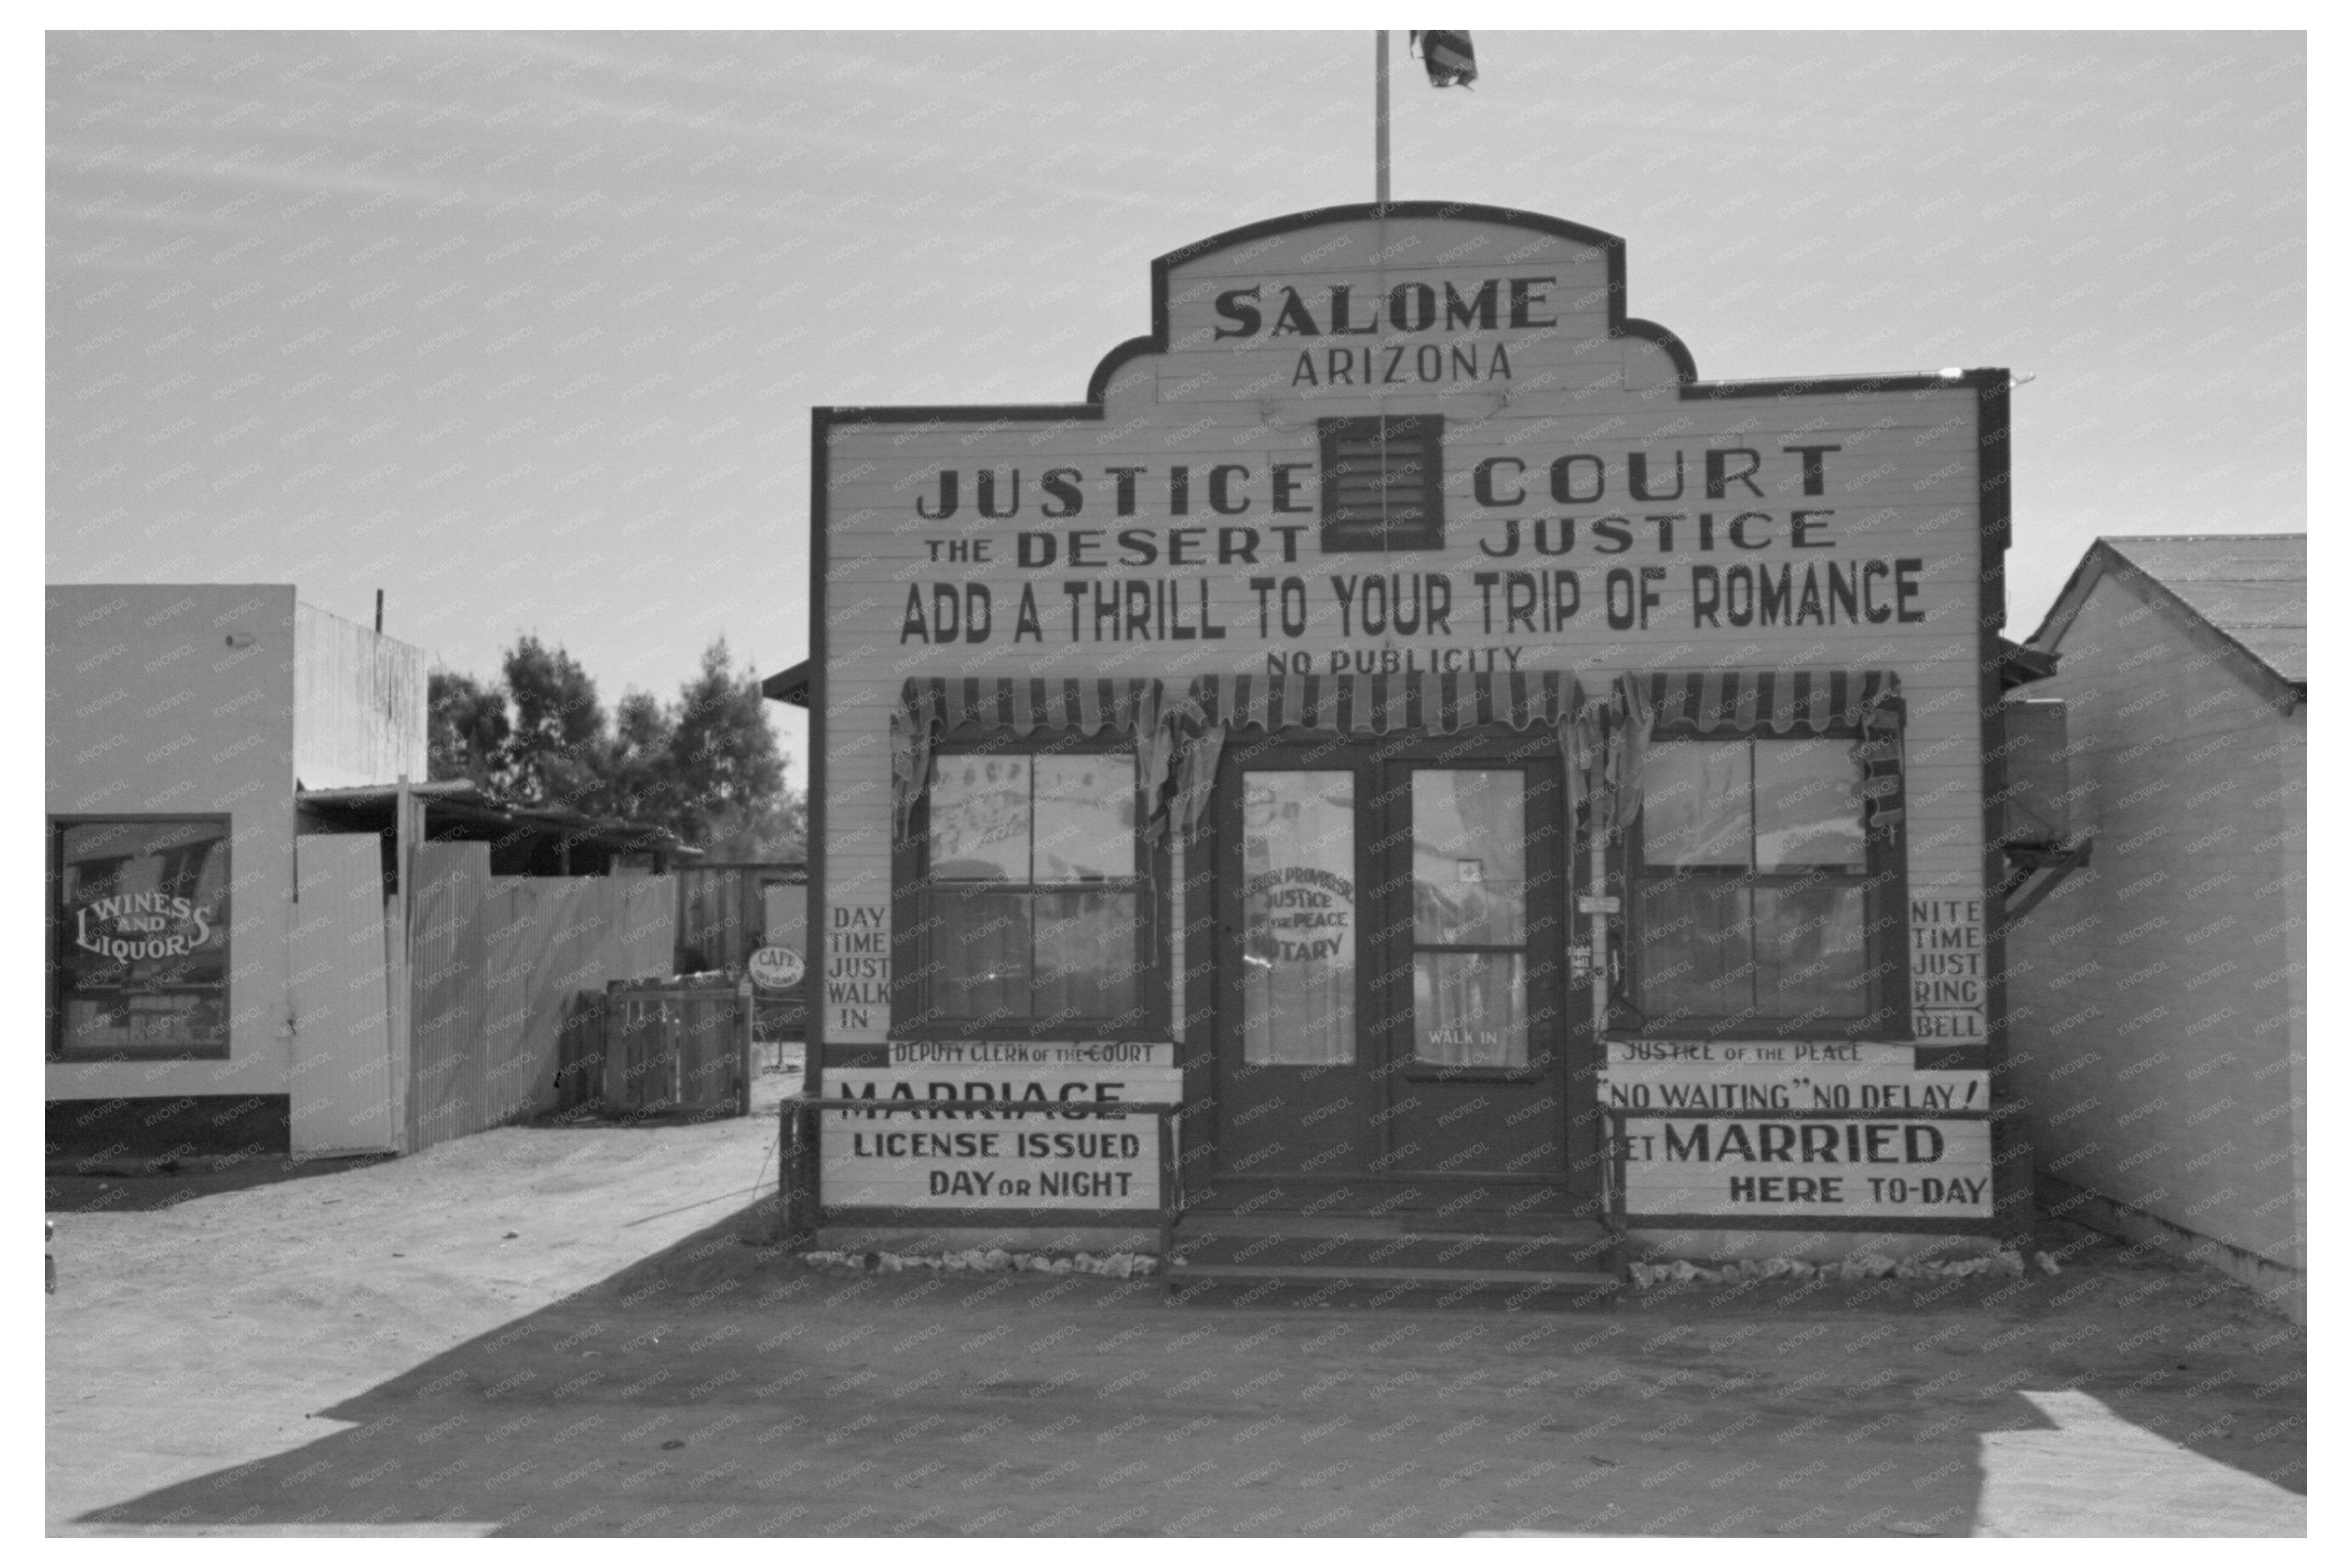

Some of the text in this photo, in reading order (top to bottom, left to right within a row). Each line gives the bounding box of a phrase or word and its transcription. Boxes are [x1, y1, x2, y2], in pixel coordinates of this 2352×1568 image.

[1214, 277, 1558, 341] SALOME
[1292, 342, 1512, 387] ARIZONA
[917, 445, 1842, 520] JUSTICE COURT
[925, 509, 1837, 568] THE DESERT JUSTICE
[901, 558, 1926, 644] ADD A THRILL TO YOUR TRIP OF ROMANCE
[1267, 646, 1523, 675] NO PUBLICITY
[90, 893, 191, 921] WINES
[1264, 887, 1332, 909] JUSTICE
[834, 907, 886, 928] DAY
[1294, 911, 1349, 928] PEACE
[1912, 901, 1980, 923] NITE
[76, 905, 211, 965] LIQUORS
[117, 916, 166, 932] AND
[829, 932, 887, 953] TIME
[1913, 927, 1980, 949] TIME
[828, 957, 890, 978] JUST
[1914, 953, 1981, 975] JUST
[828, 982, 891, 1003] WALK
[1914, 980, 1977, 1002] RING
[841, 1008, 868, 1028] IN
[1916, 1015, 1982, 1037] BELL
[1429, 1030, 1498, 1045] WALK IN
[895, 1042, 1155, 1063] DEPUTY CLERK OF THE COURT
[1623, 1042, 1863, 1062] JUSTICE OF THE PEACE
[841, 1082, 1127, 1120] MARRIAGE
[1814, 1084, 1851, 1109] NO
[854, 1132, 1140, 1159] LICENSE ISSUED
[1665, 1123, 1945, 1163] MARRIED
[929, 1170, 1133, 1197] DAY OR NIGHT
[1730, 1176, 1989, 1205] HERE TO-DAY
